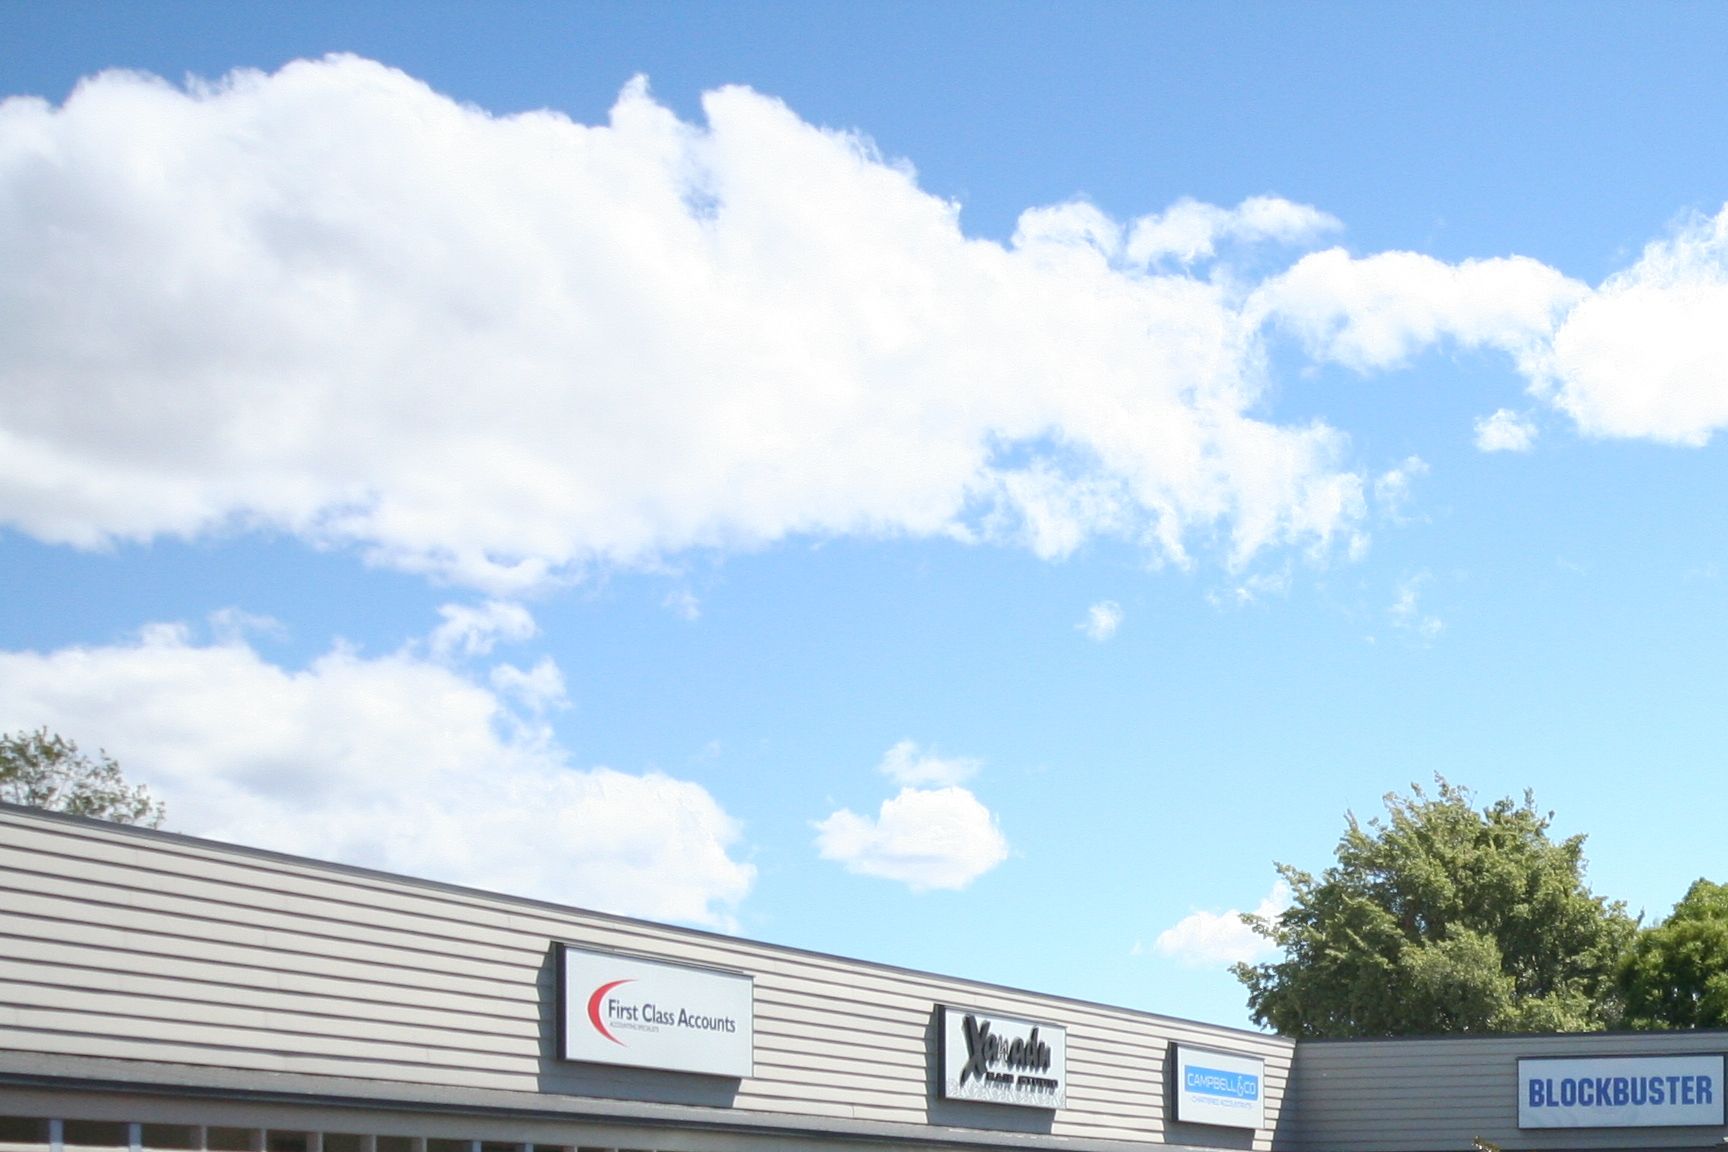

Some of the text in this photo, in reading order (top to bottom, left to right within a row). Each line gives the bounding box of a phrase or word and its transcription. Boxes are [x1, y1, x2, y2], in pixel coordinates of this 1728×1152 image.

[608, 998, 736, 1033] First Class Accounts
[1529, 1075, 1713, 1108] BLOCKBUSTER
